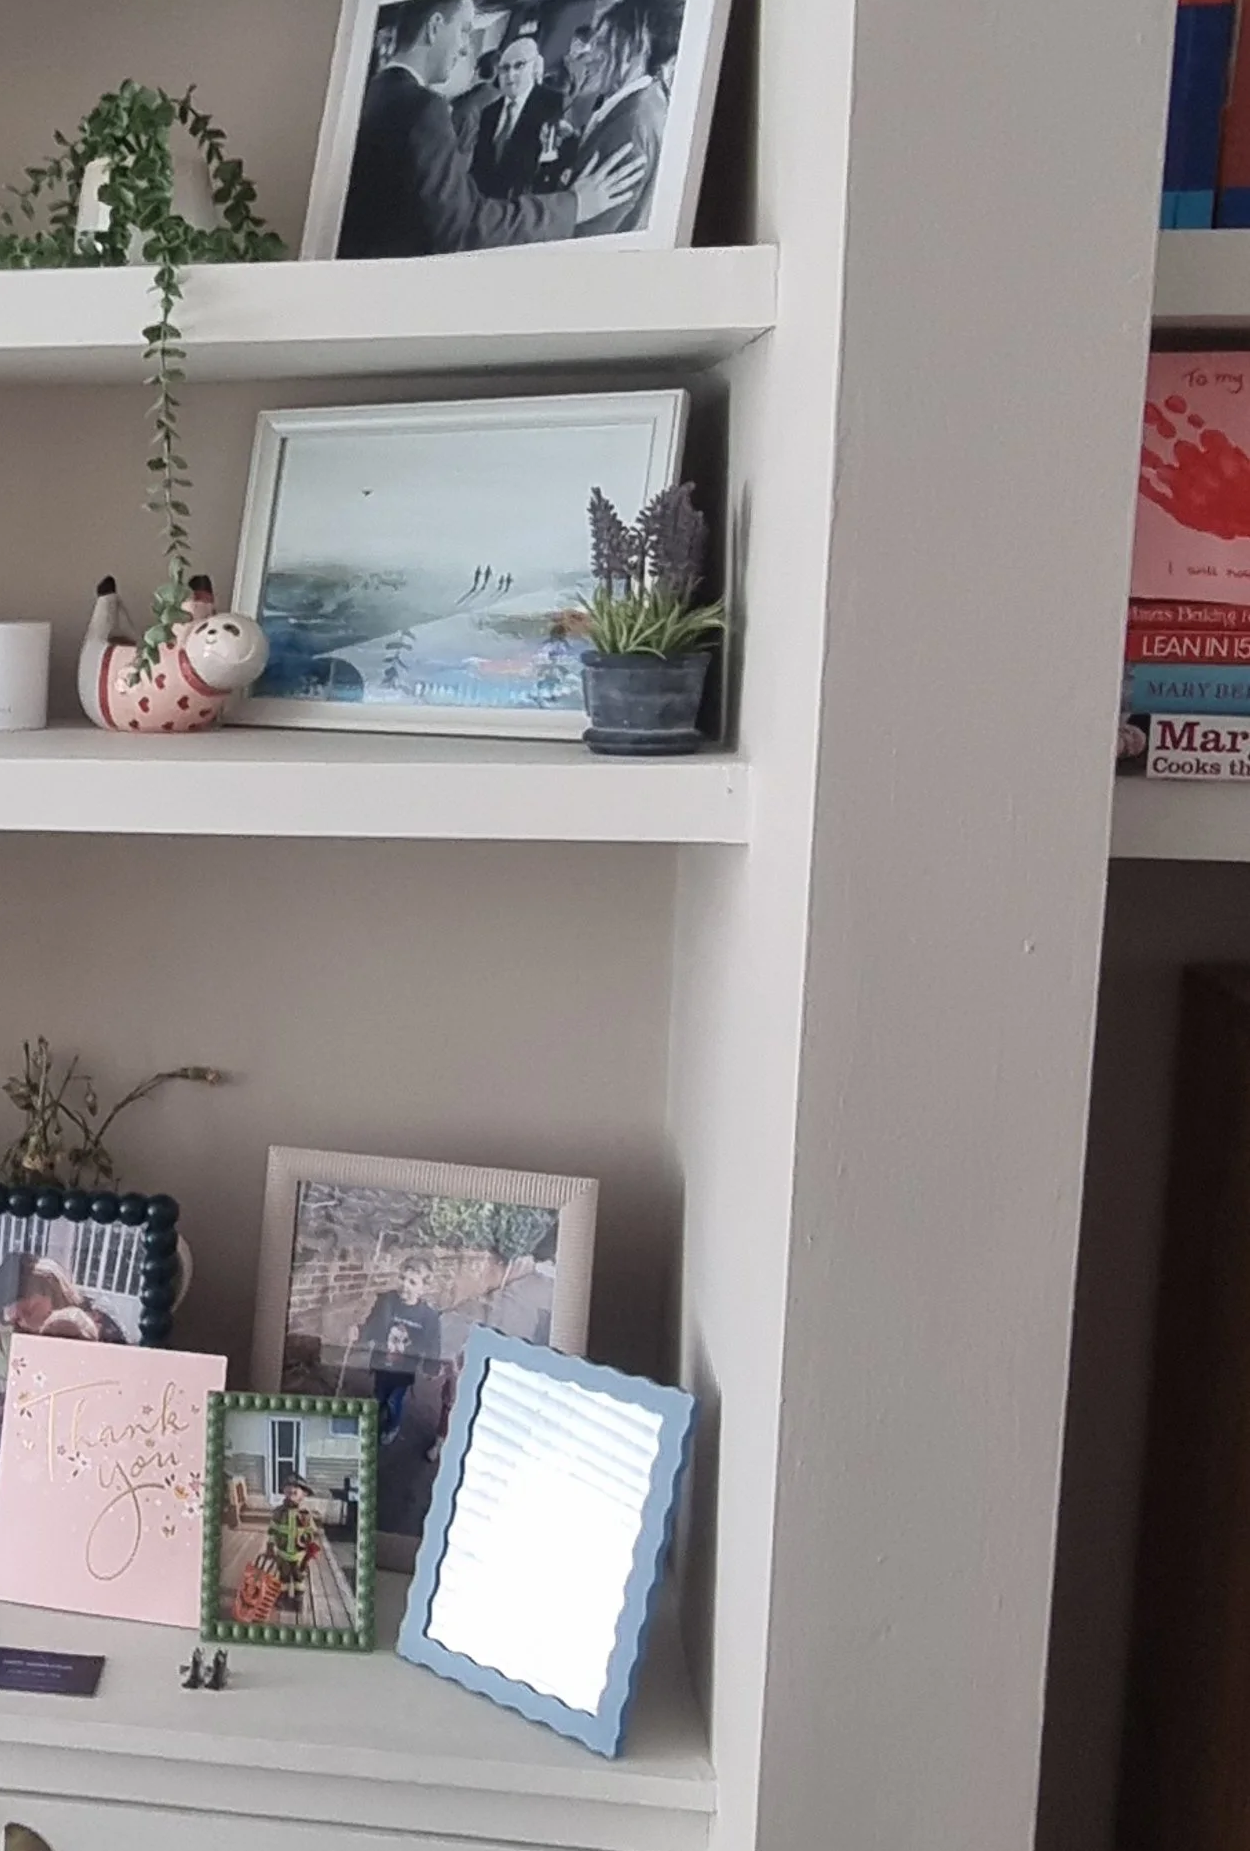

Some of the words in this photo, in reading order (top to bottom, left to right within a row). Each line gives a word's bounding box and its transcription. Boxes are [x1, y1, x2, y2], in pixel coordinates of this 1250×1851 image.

[1183, 370, 1208, 387] To
[1215, 372, 1243, 394] my
[1142, 636, 1201, 658] LEAN
[1205, 637, 1229, 658] IN
[1146, 680, 1211, 699] MARY
[1155, 720, 1250, 762] Mar
[1153, 757, 1221, 776] Cooks
[18, 1380, 190, 1482] Thank
[85, 1451, 180, 1580] you
